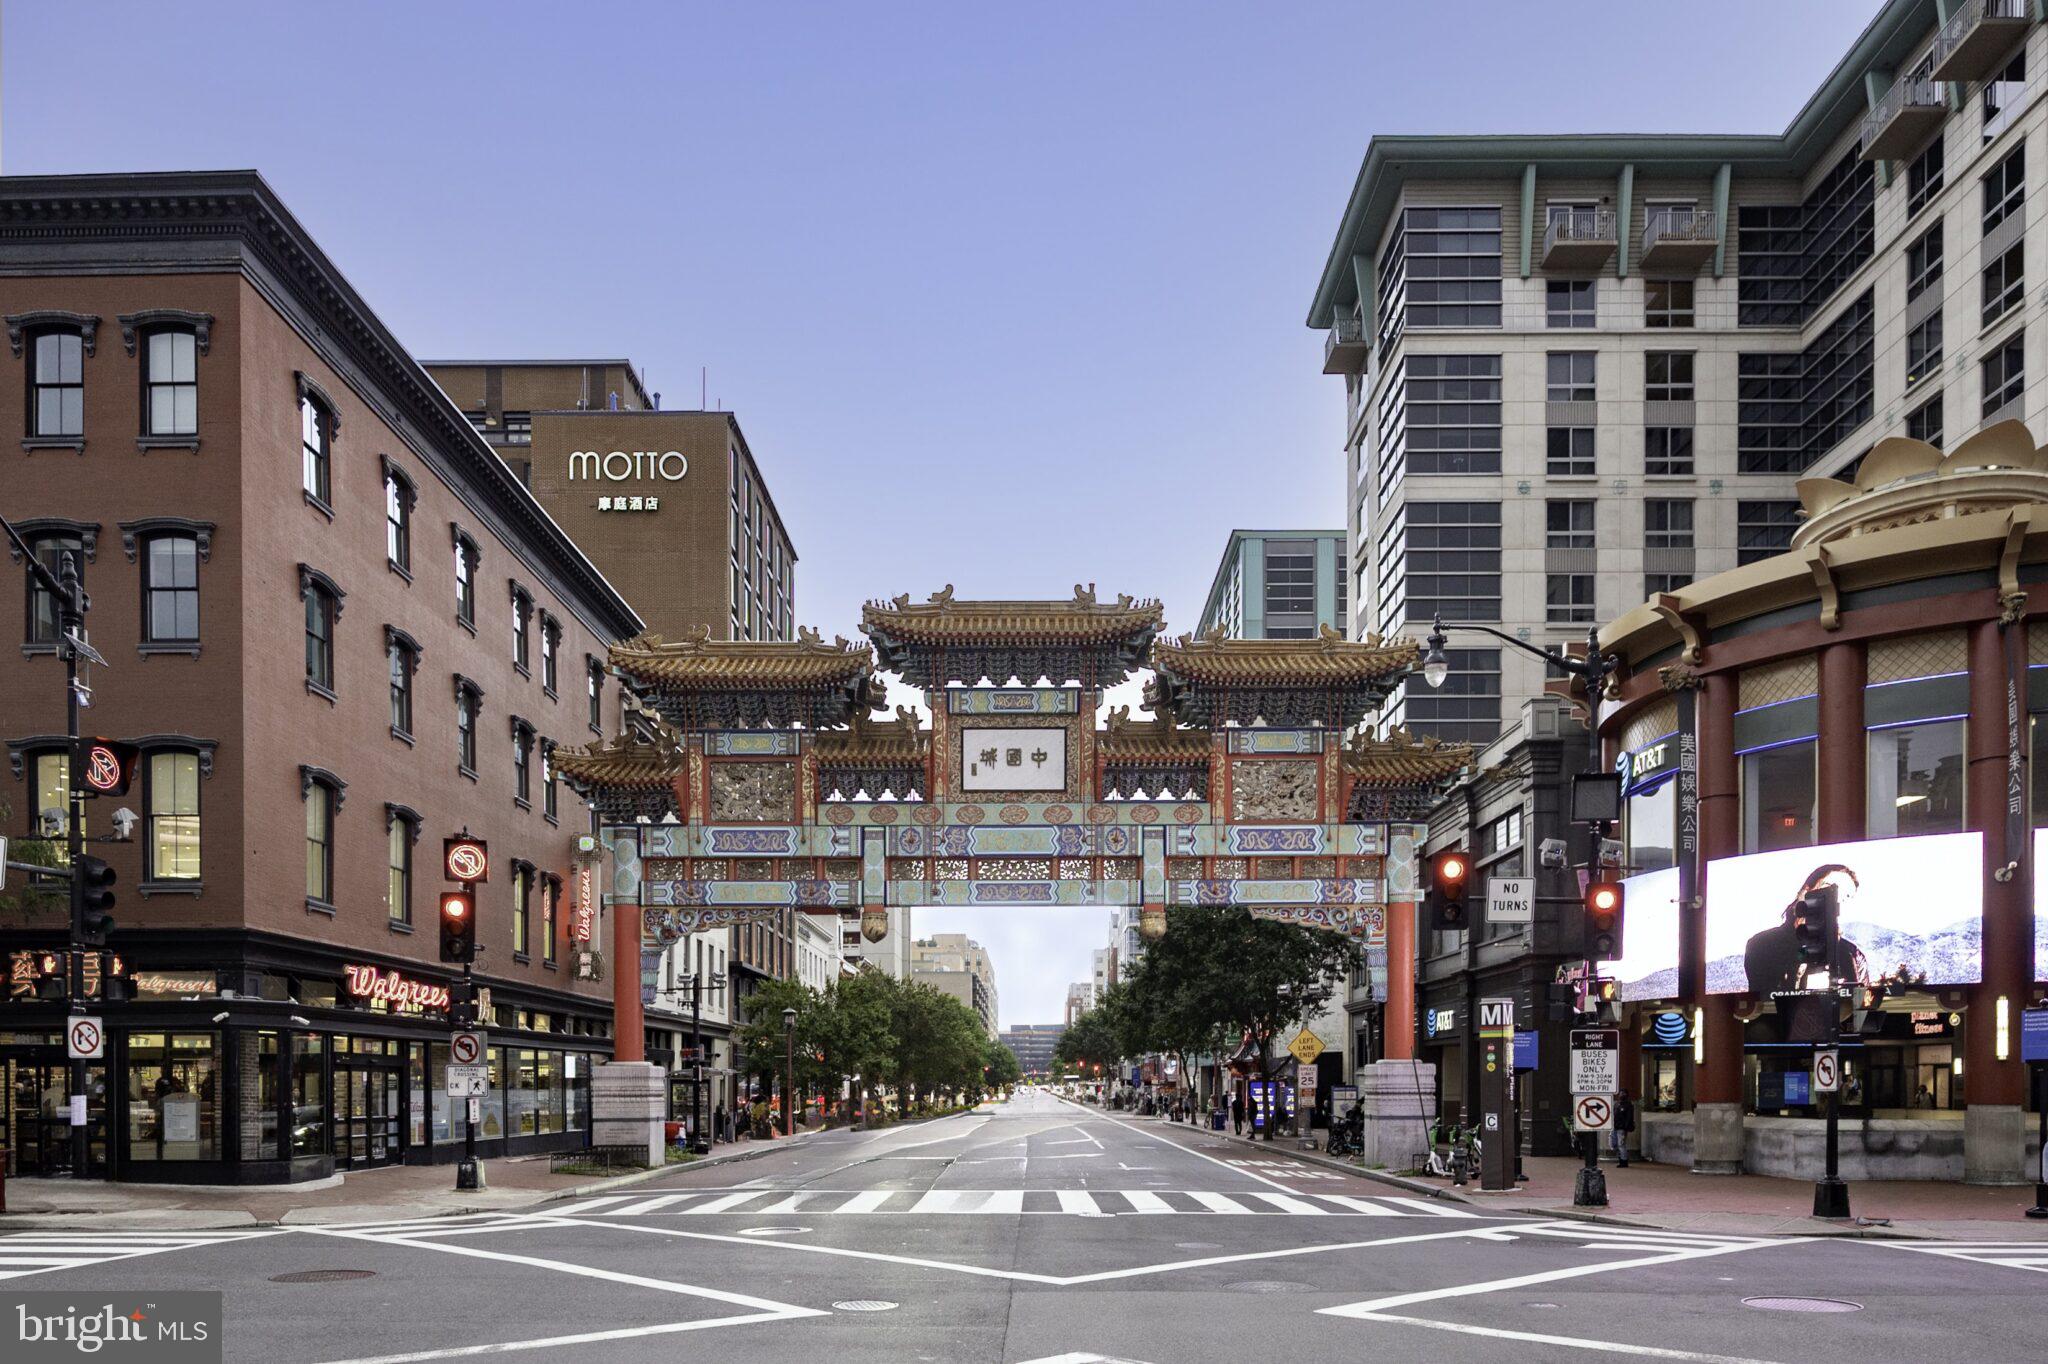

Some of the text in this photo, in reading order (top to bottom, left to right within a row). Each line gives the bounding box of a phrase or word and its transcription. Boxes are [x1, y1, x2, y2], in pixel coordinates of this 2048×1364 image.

[569, 451, 688, 481] MOTTO
[1632, 743, 1668, 778] AT&T
[1680, 733, 1697, 853] 美國娛樂公司
[1503, 883, 1519, 894] NO
[578, 869, 591, 942] Walgreens
[1493, 900, 1528, 911] TURNS
[1436, 1010, 1454, 1032] AT&T
[1481, 1004, 1501, 1026] M
[1502, 1004, 1513, 1025] M
[1301, 1076, 1314, 1085] 25
